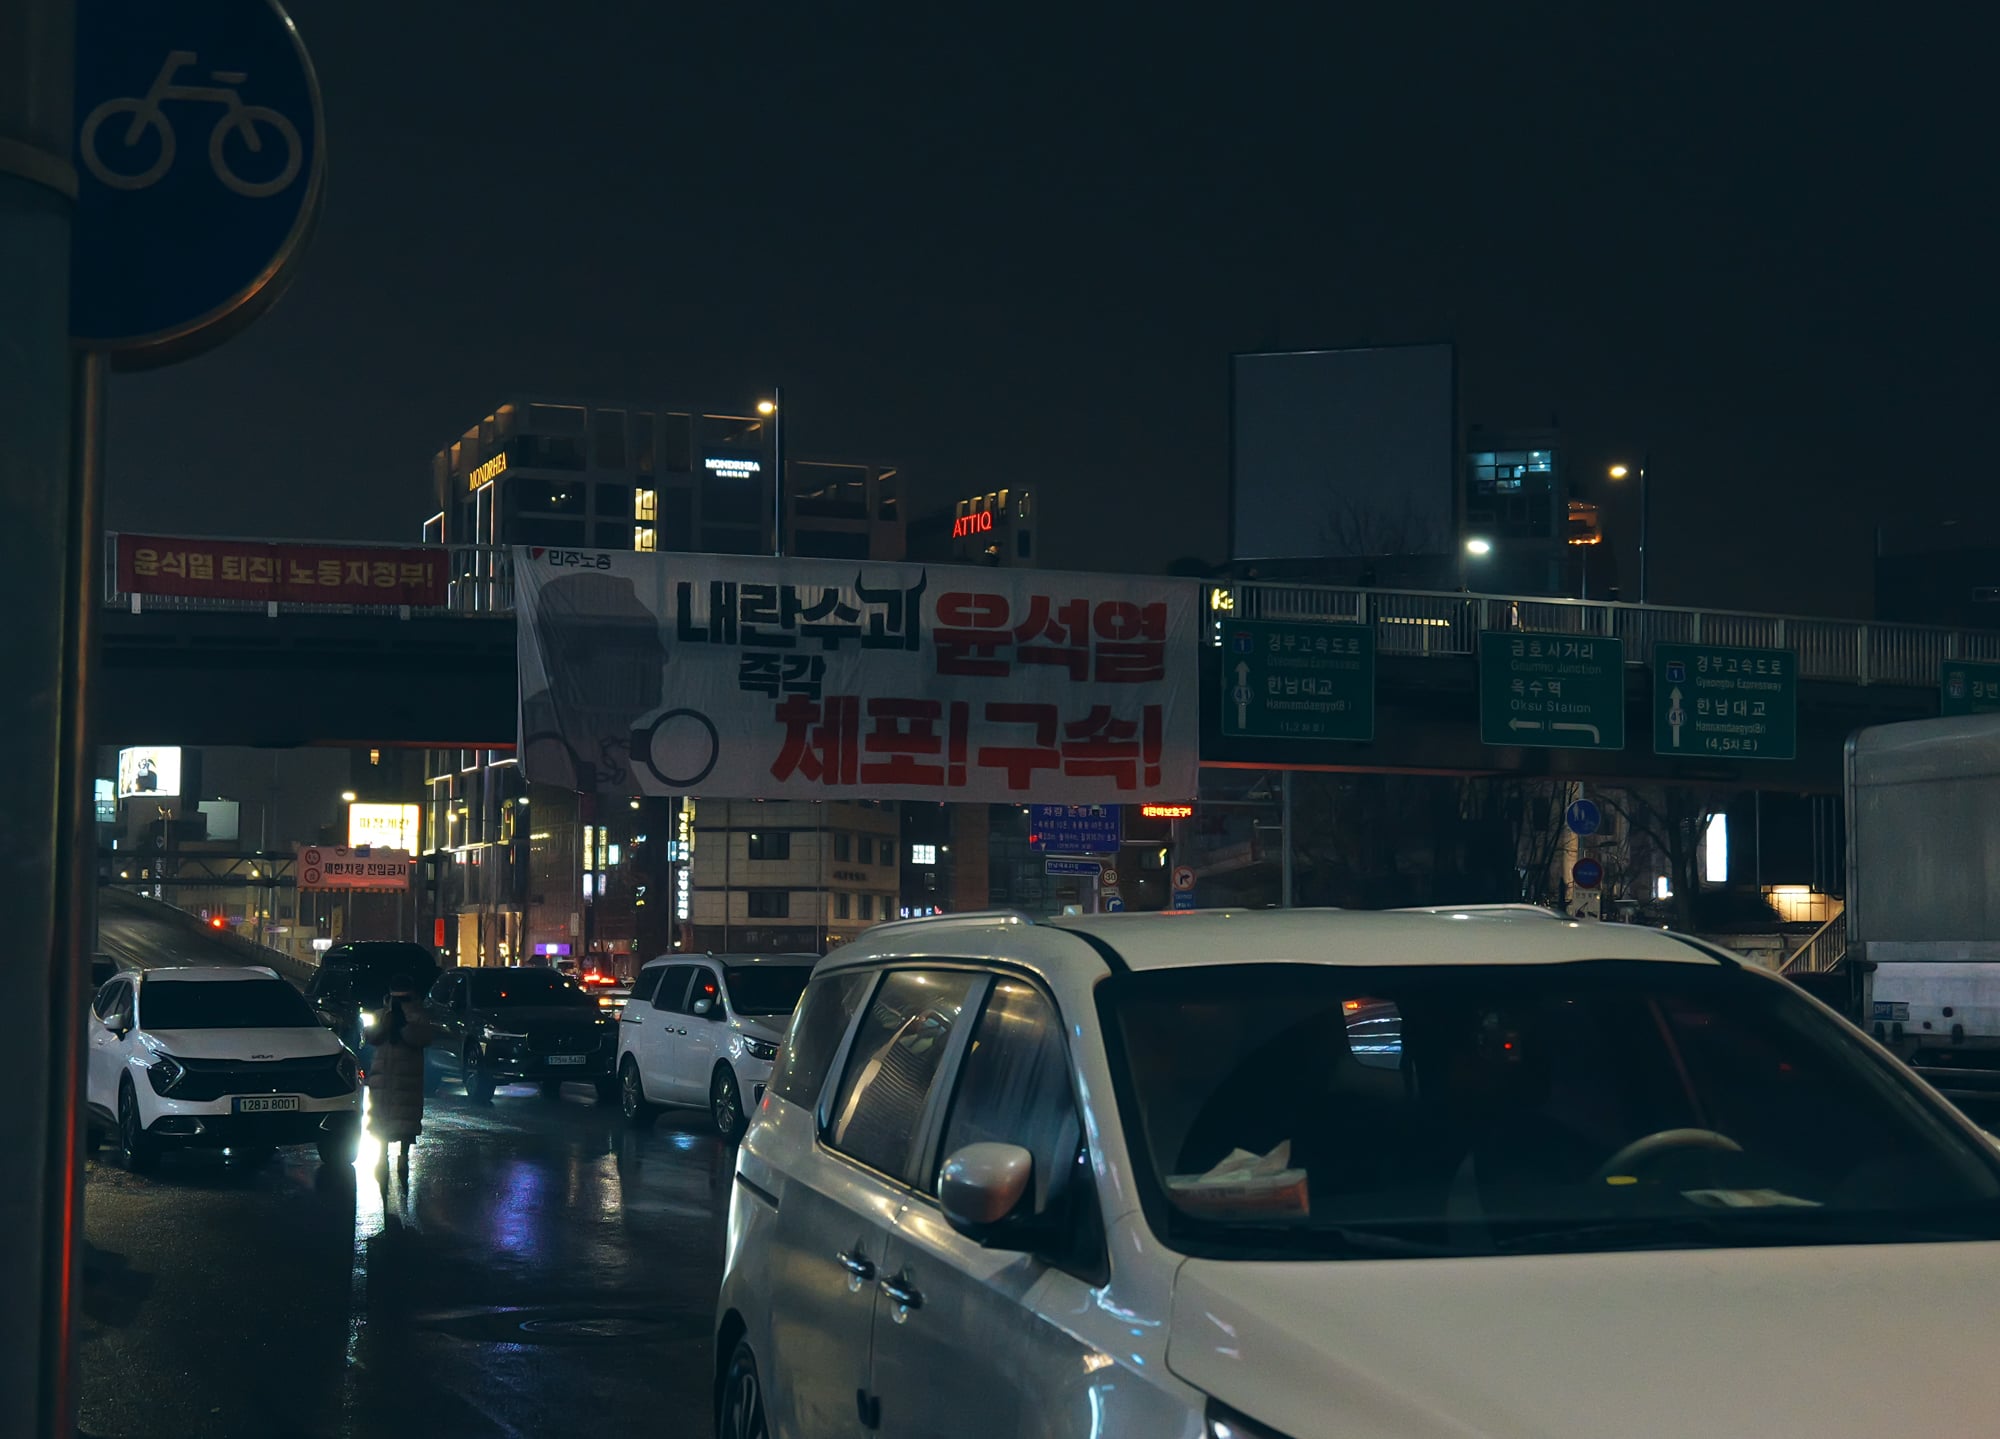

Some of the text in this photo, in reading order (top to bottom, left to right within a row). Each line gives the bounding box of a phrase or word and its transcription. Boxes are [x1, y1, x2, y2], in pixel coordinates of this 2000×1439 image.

[952, 511, 992, 539] ATTIQ
[134, 548, 433, 589] 윤석열 퇴진! 노동자정부!
[549, 550, 611, 570] 민주노총
[677, 566, 1167, 683] 내란수괴 윤석열
[1267, 632, 1360, 655] 경부고속도로
[1510, 640, 1594, 660] 금호사거리
[1696, 655, 1783, 675] 경부고속도로
[738, 652, 826, 700] 즉각
[1267, 677, 1333, 696] 한남대교
[1510, 678, 1561, 698] 옥수역
[1510, 699, 1592, 713] Oksu Station
[1696, 696, 1767, 717] 한남대교
[1043, 806, 1063, 817] 차량
[323, 862, 406, 876] 제한차량 진입금지
[1105, 872, 1116, 882] 30
[243, 1099, 295, 1110] 128고 8001
